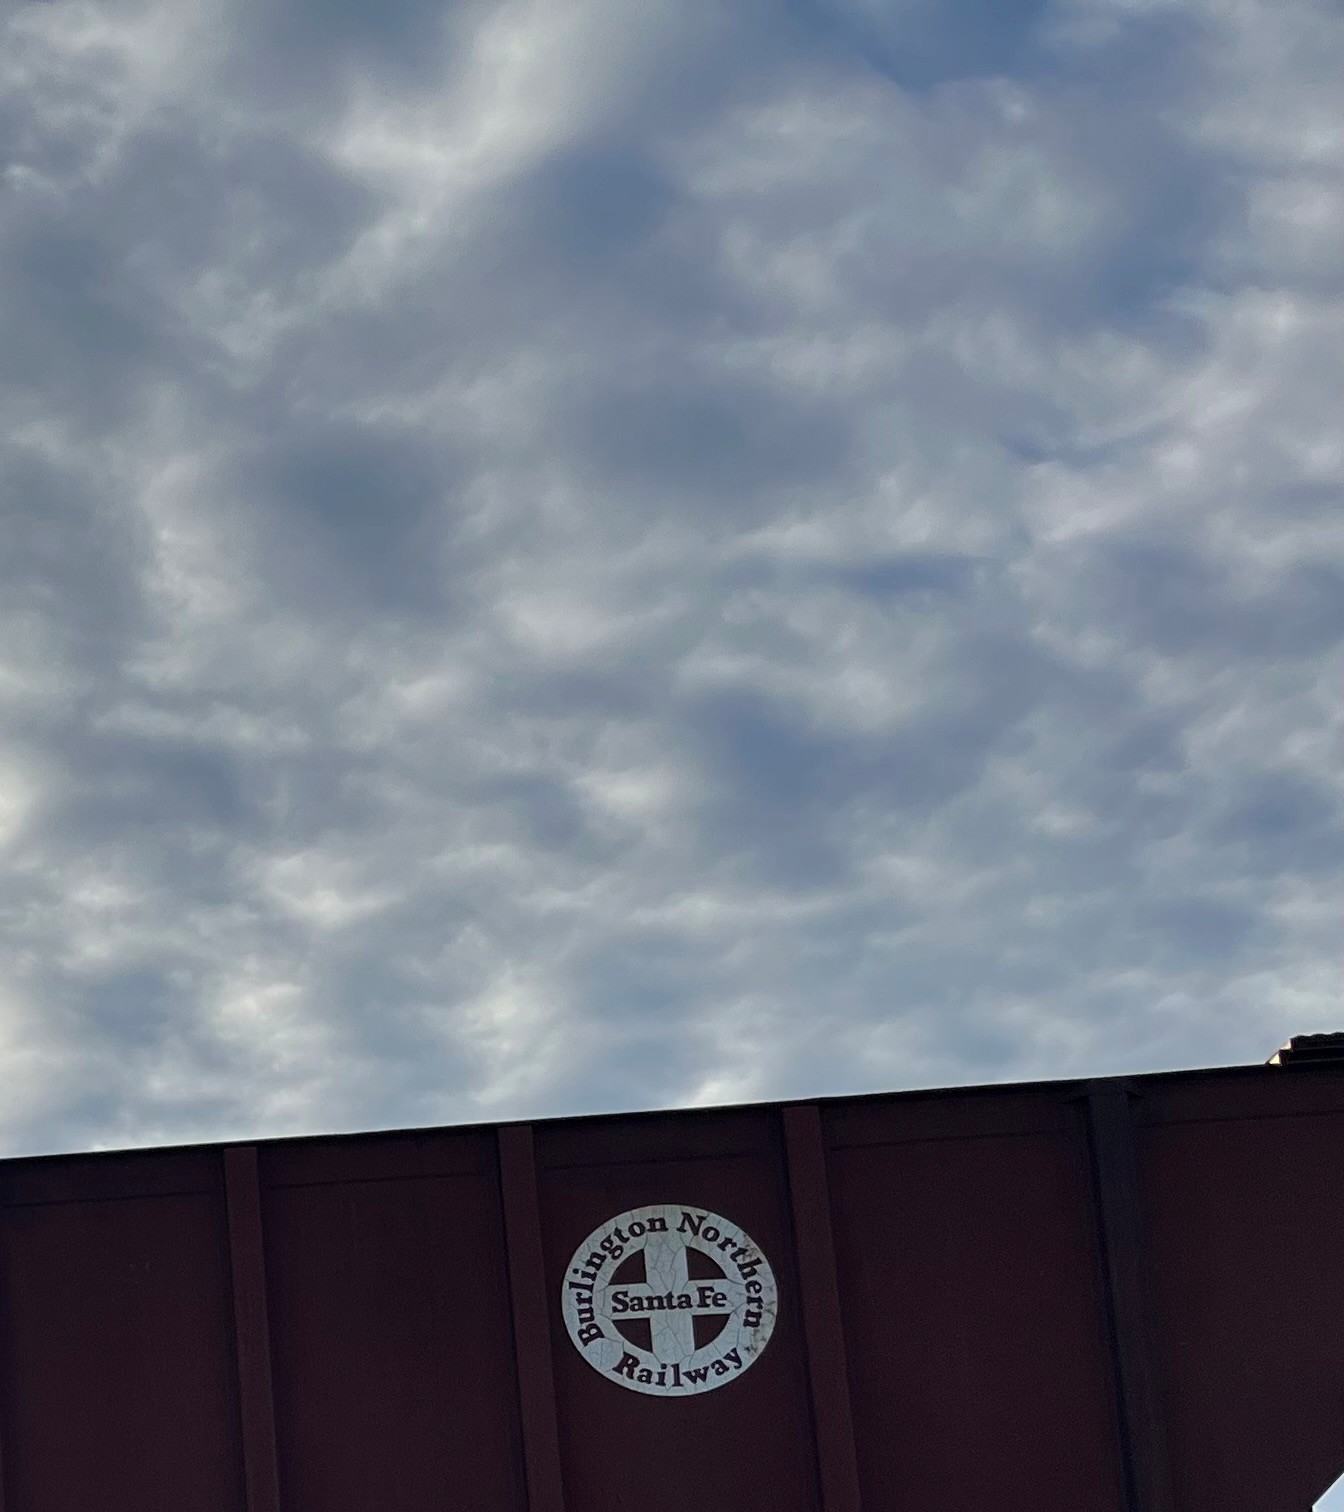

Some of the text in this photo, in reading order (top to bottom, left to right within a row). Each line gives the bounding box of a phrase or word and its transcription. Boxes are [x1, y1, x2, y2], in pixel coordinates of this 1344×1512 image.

[568, 1211, 764, 1347] Burlington Northern
[611, 1286, 728, 1314] Santa Fe
[612, 1346, 744, 1388] Railway
